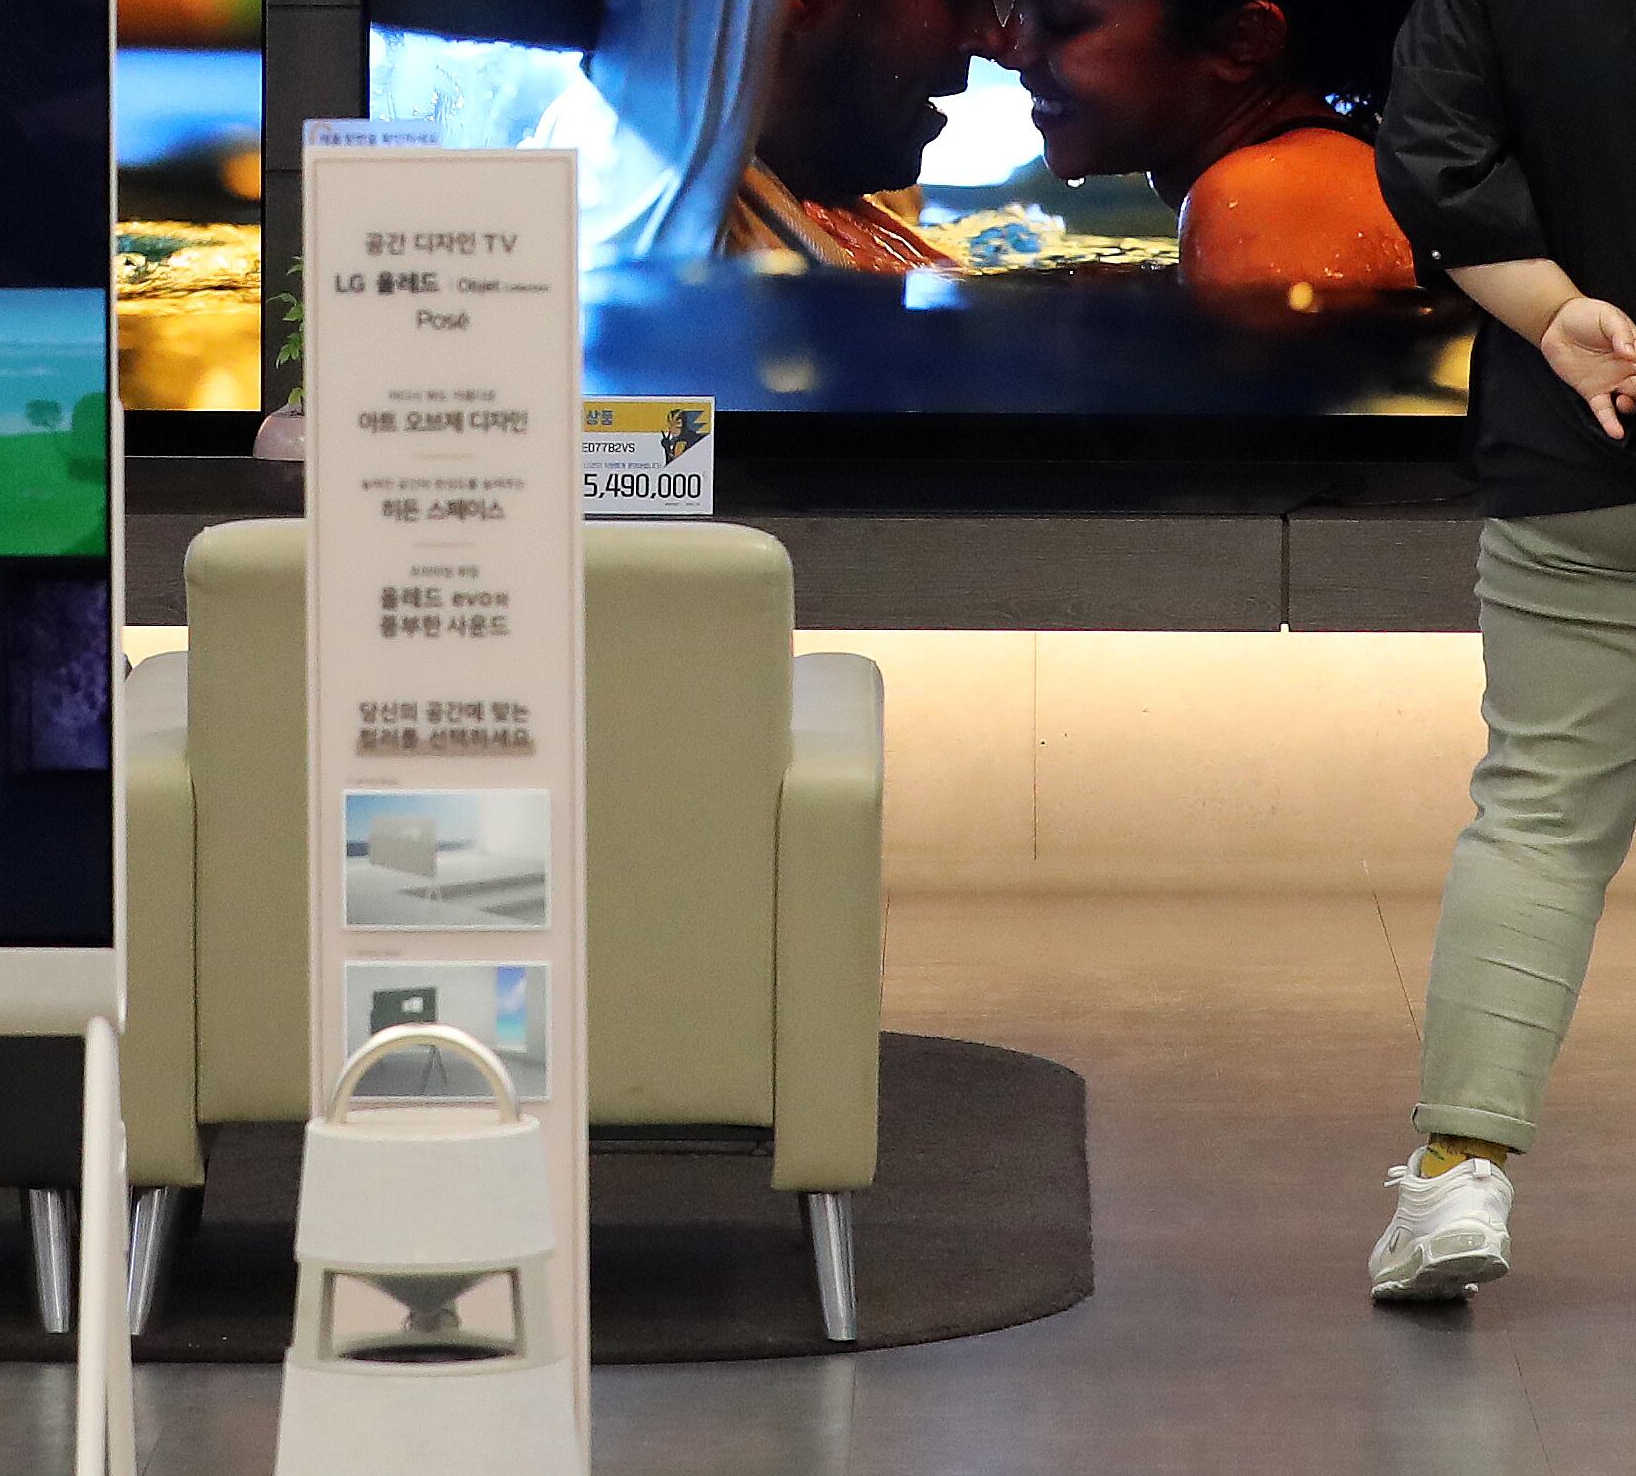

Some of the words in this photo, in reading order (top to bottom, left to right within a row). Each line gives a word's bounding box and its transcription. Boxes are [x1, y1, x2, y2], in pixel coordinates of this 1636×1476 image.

[366, 232, 406, 255] 공간
[415, 232, 476, 255] 디자인
[483, 234, 518, 253] TV
[334, 274, 365, 293] LG
[377, 271, 439, 294] 올레드
[359, 411, 396, 434] 아트
[404, 411, 464, 434] 오브제
[470, 411, 528, 434] 디자인
[584, 474, 701, 498] 5,490,000
[427, 498, 505, 521] 스페이스
[381, 586, 442, 610] 올레드
[380, 615, 440, 638] 풍부한
[447, 615, 510, 638] 사운드
[359, 701, 417, 723] 당신의
[426, 701, 484, 723] 공간에
